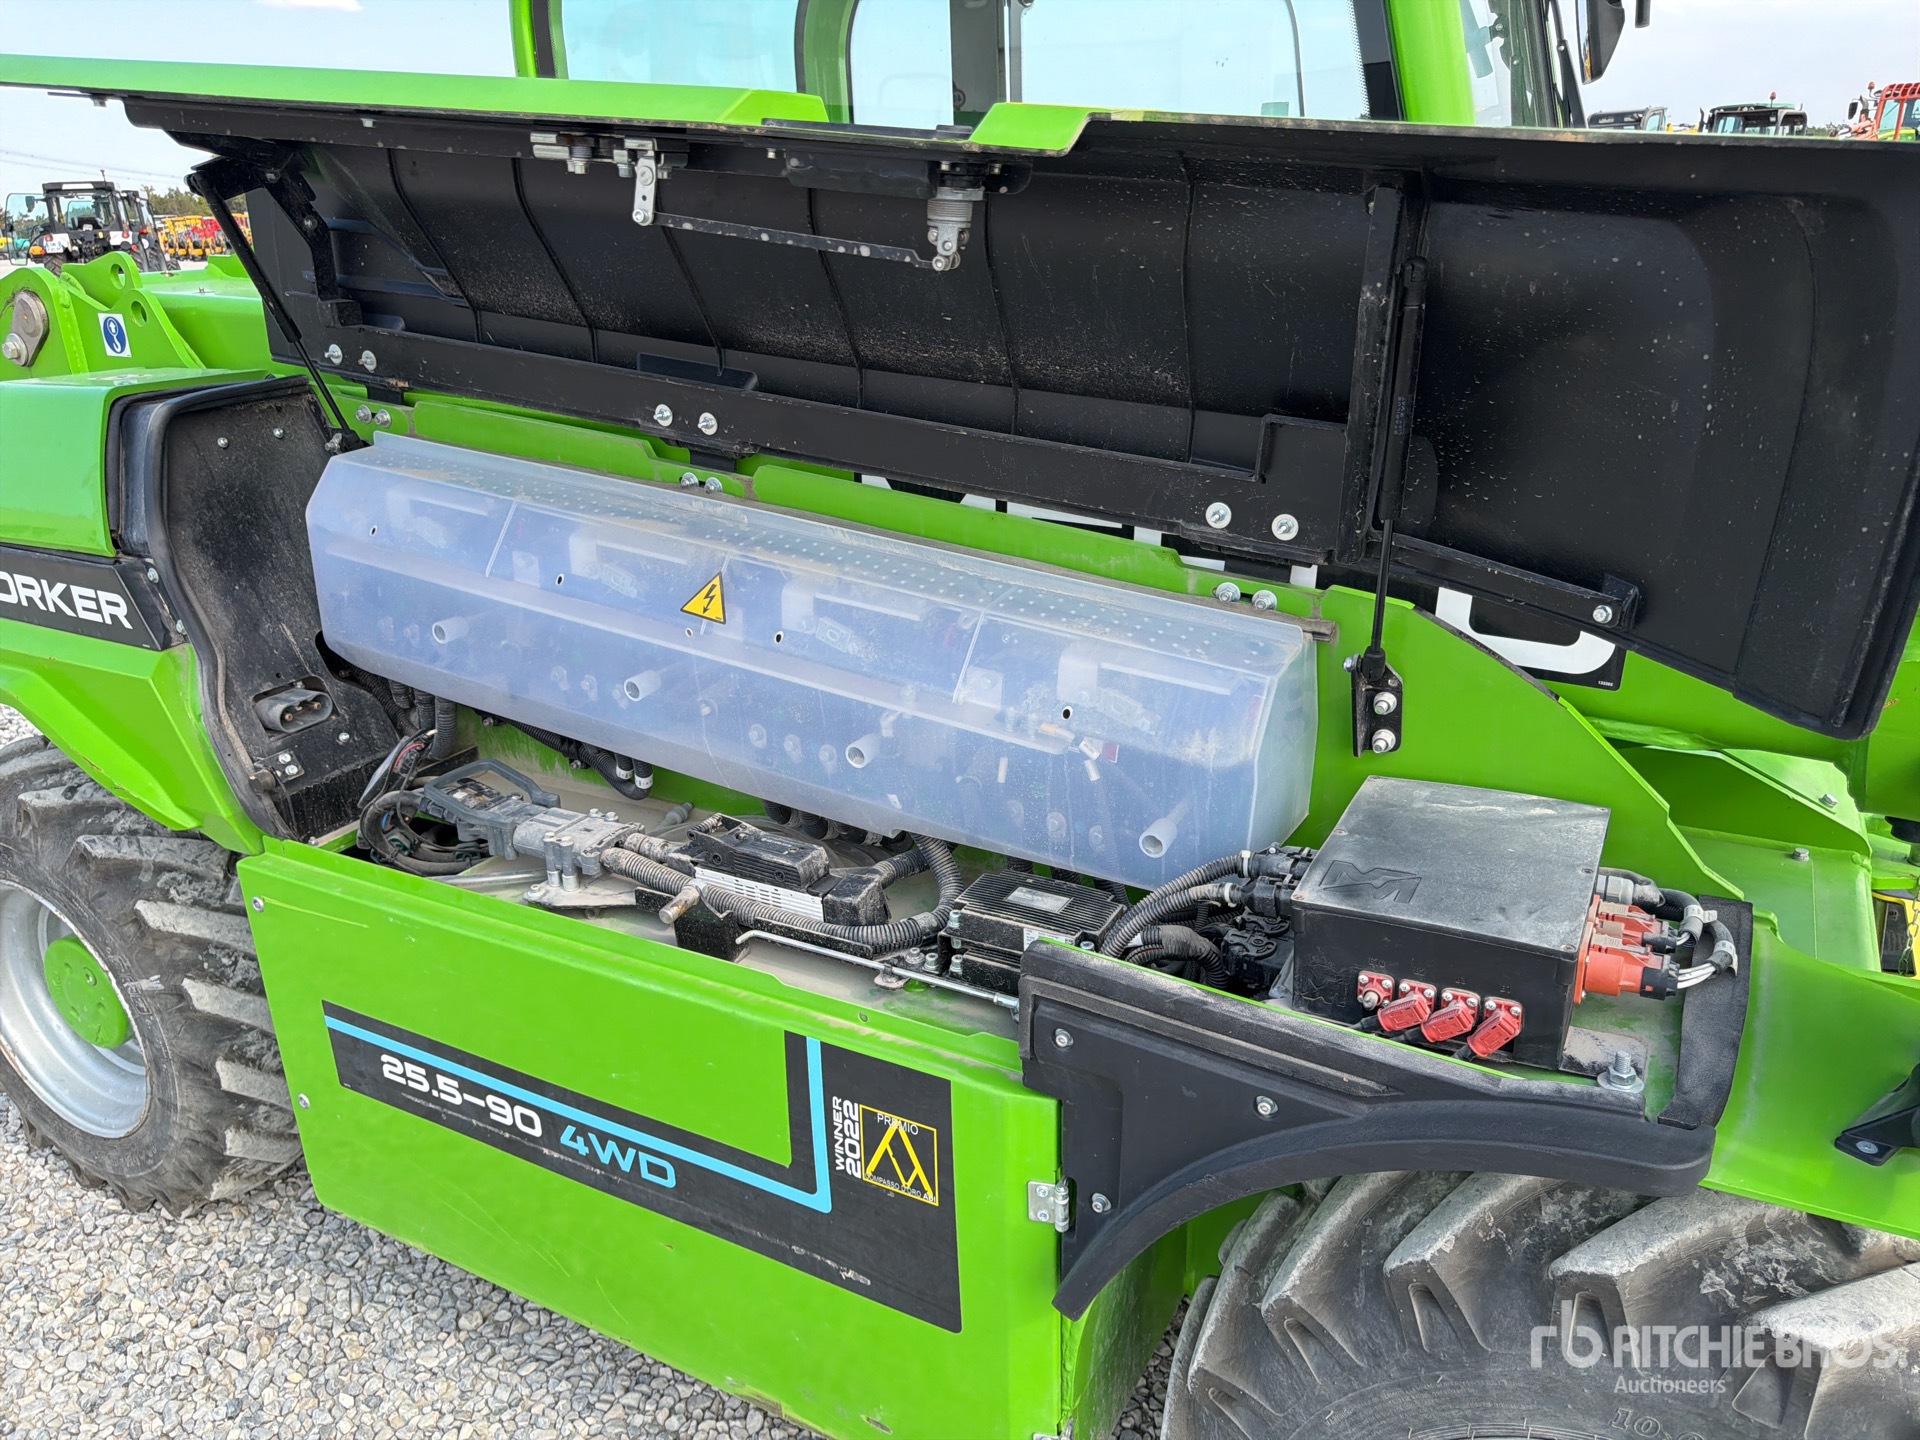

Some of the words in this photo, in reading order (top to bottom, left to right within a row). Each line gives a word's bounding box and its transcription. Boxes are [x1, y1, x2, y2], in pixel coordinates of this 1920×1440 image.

[381, 1054, 542, 1138] 25.5-90
[560, 1125, 676, 1189] 4WD
[832, 1095, 845, 1172] WINNER
[842, 1099, 862, 1180] 2022
[876, 1112, 919, 1136] PREMIO
